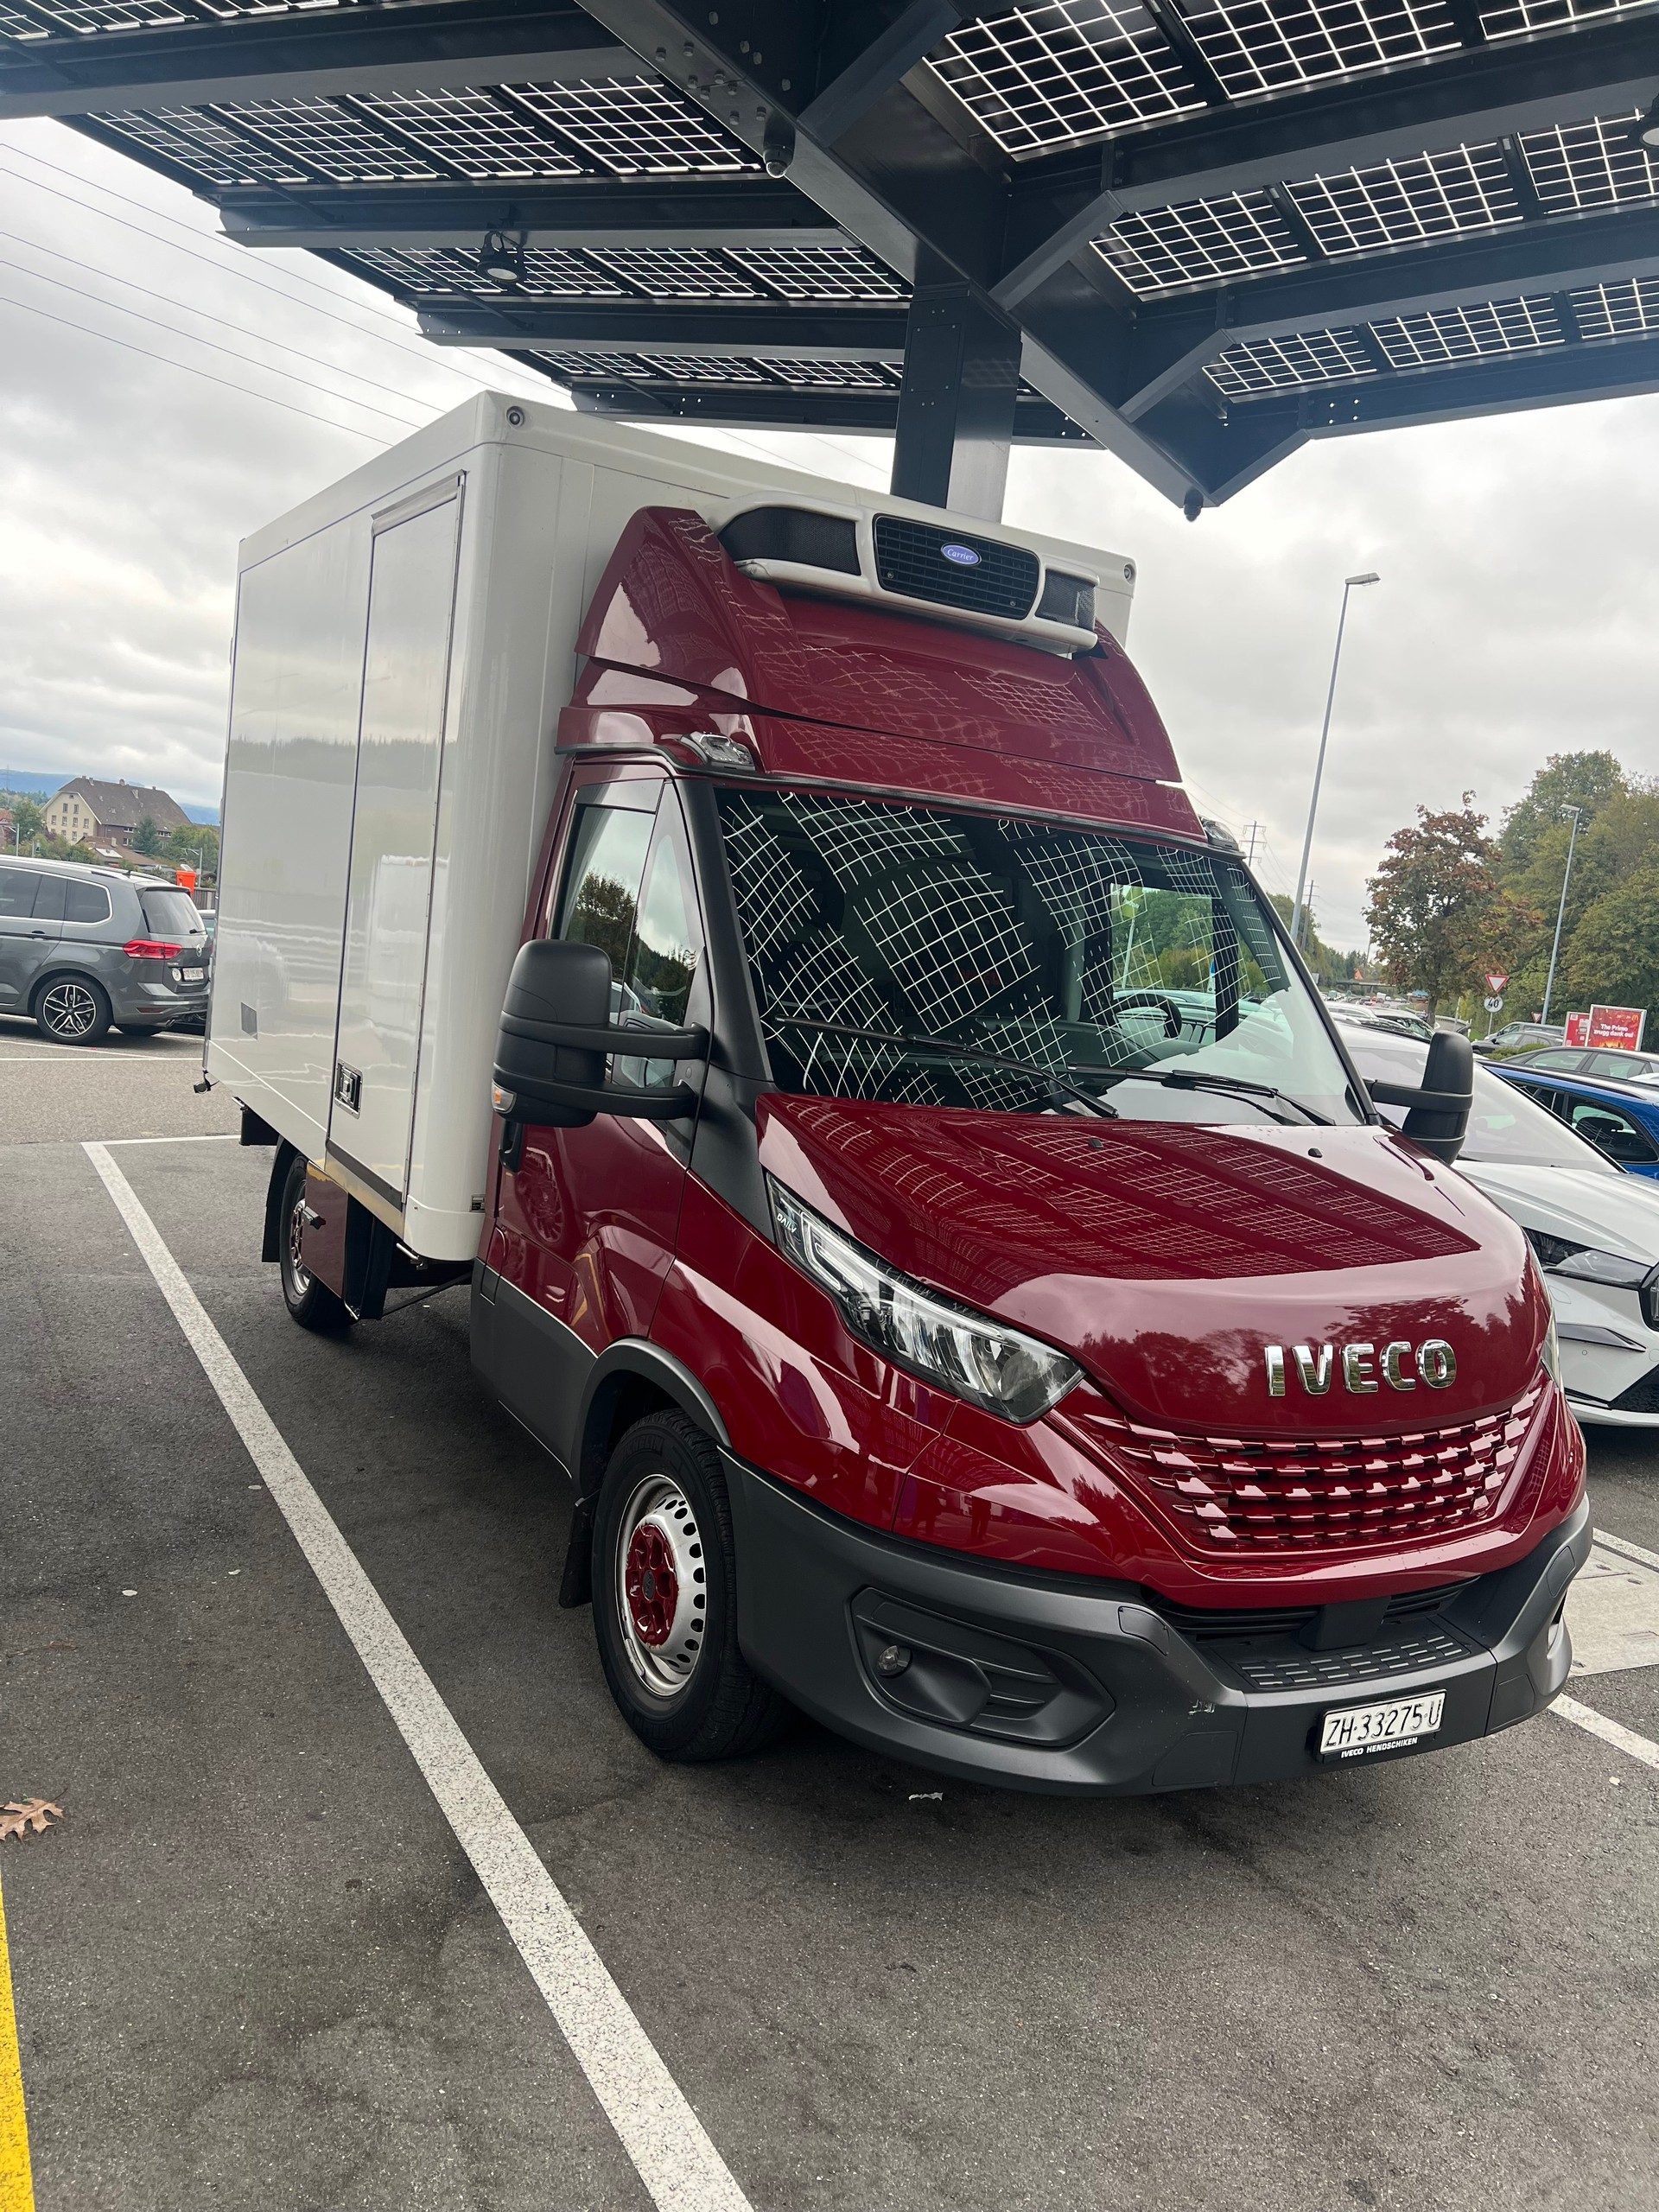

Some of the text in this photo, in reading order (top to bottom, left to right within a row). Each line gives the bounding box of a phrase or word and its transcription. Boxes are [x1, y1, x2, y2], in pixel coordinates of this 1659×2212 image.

[947, 549, 974, 561] Carrier
[1488, 998, 1499, 1008] 40
[777, 1213, 798, 1233] DAILY
[1264, 1338, 1458, 1397] IVECO
[1340, 1737, 1418, 1758] IVECO HENDSCHIKEN
